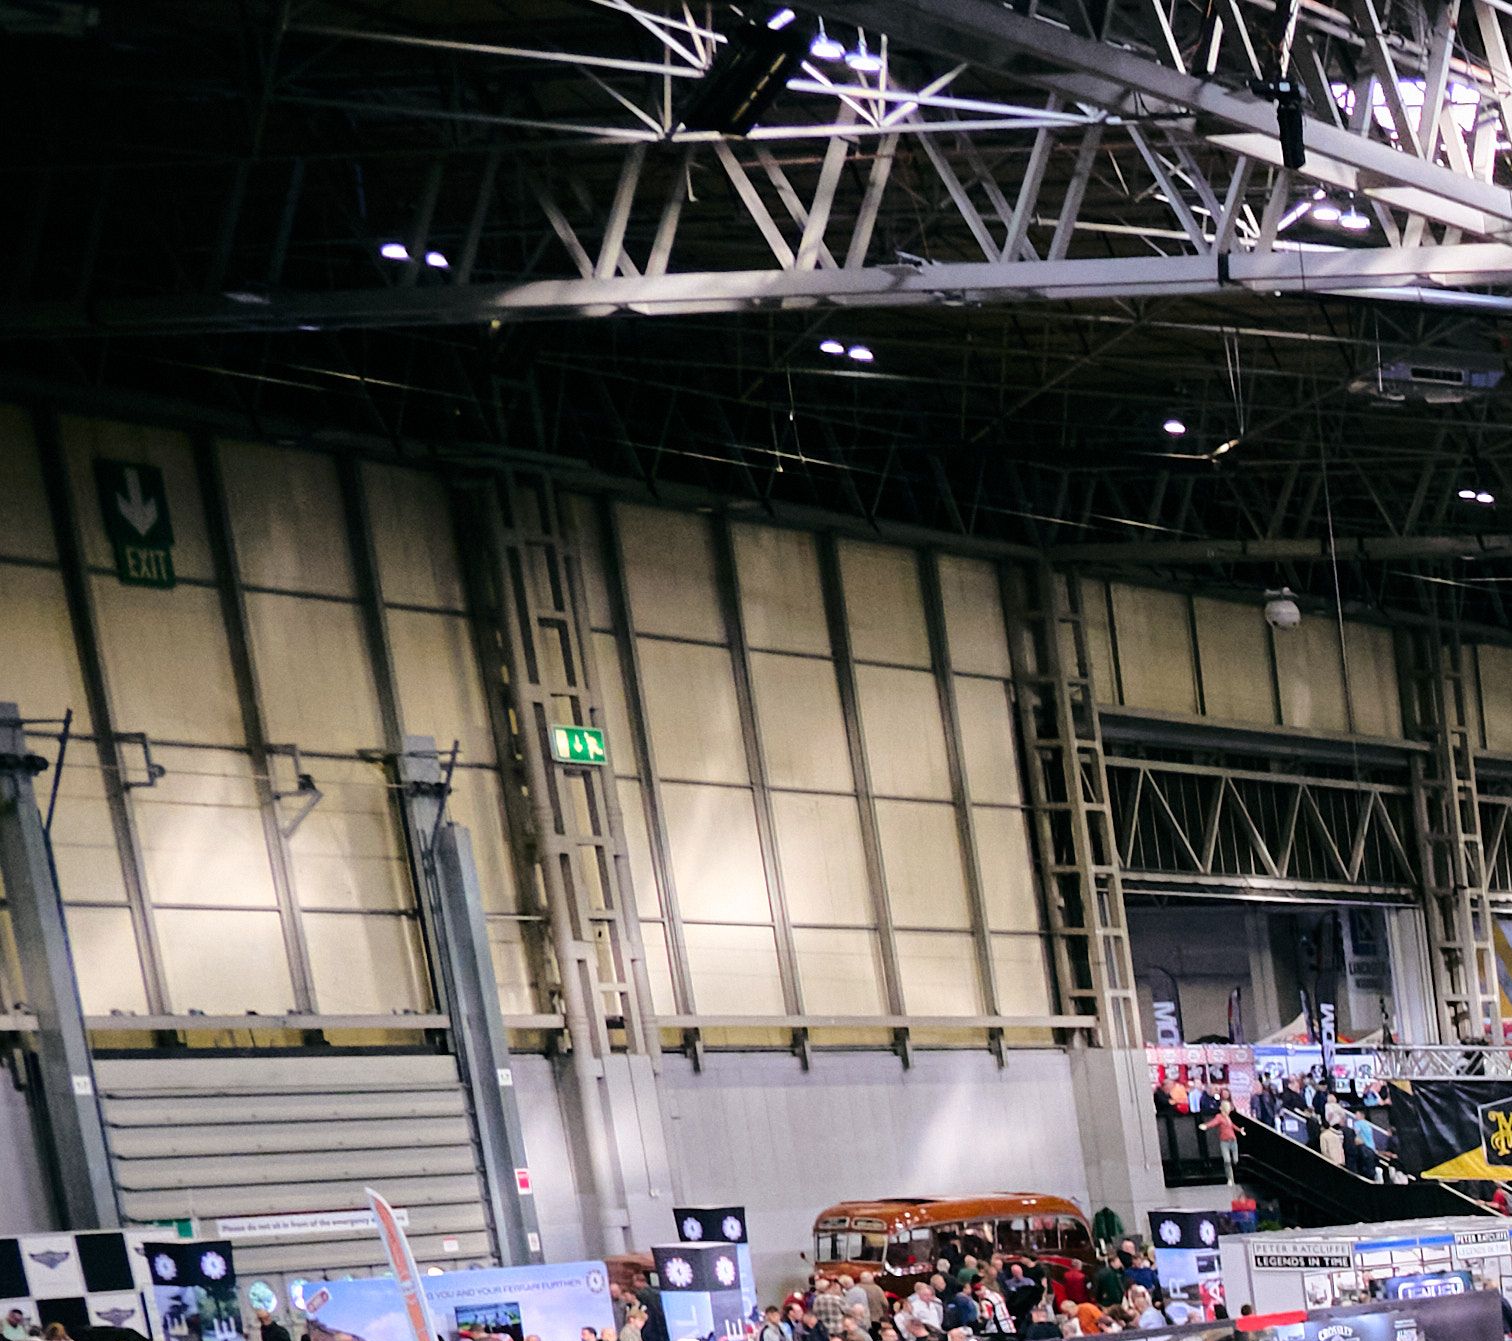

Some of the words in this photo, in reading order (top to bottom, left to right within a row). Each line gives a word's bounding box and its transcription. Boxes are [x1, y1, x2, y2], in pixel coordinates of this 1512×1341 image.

[126, 547, 170, 582] EXIT
[1256, 1256, 1305, 1268] LEGENDS
[1308, 1257, 1320, 1267] IN
[1323, 1256, 1350, 1267] TIME
[542, 1279, 583, 1292] FURTHER
